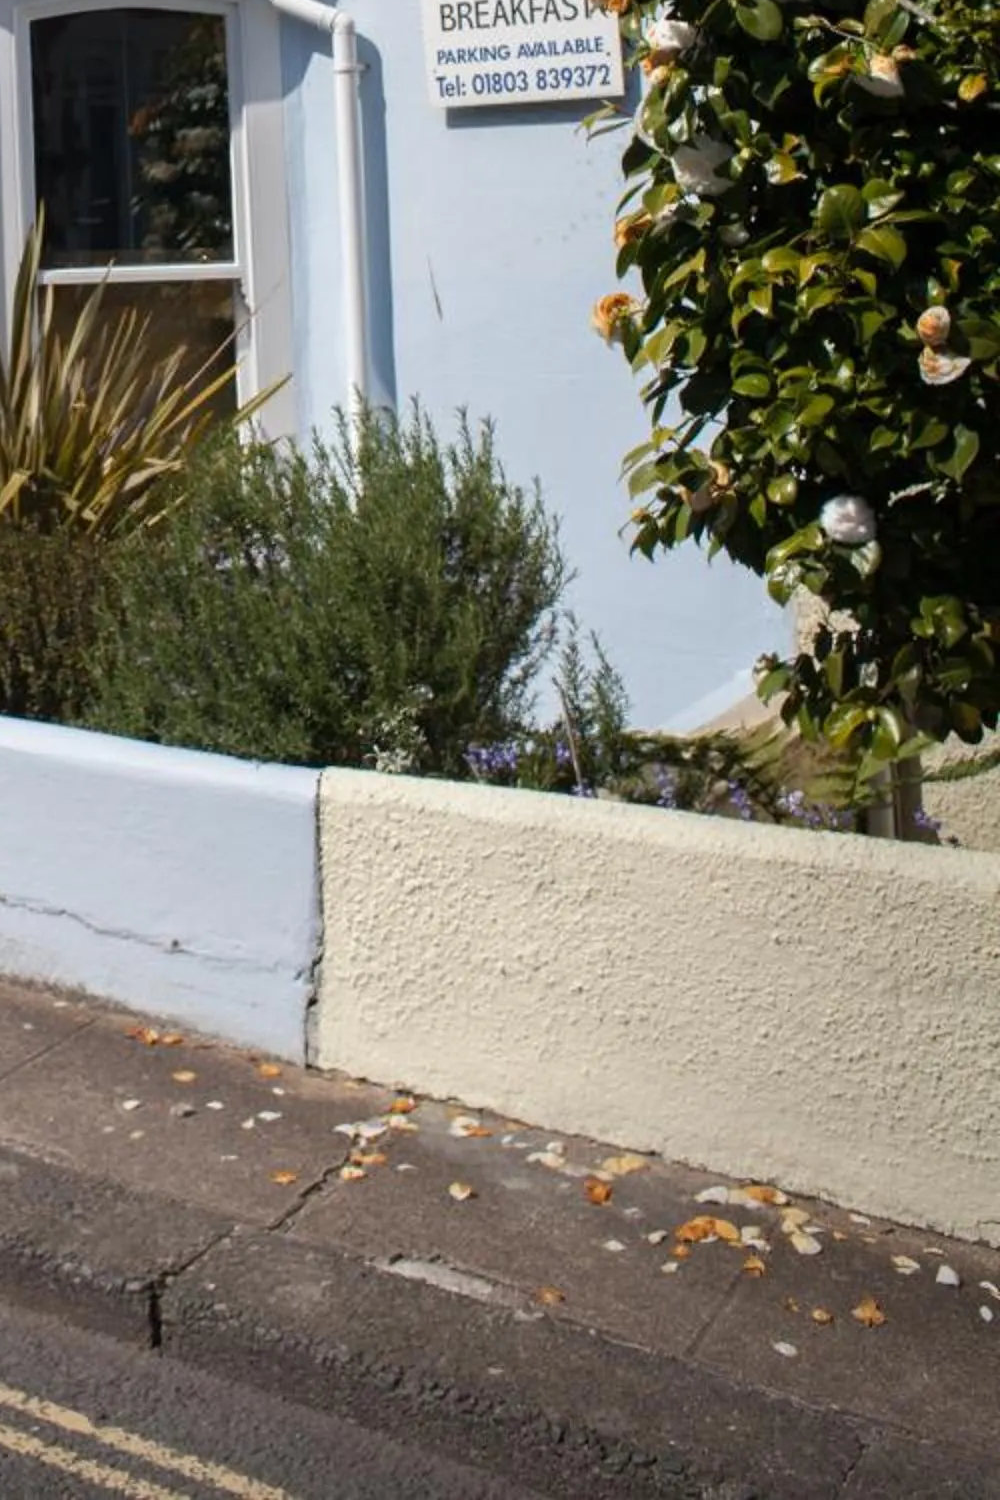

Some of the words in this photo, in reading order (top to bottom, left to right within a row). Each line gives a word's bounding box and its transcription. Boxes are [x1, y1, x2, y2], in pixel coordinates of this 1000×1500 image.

[437, 44, 511, 65] PARKING
[517, 36, 604, 59] AVAILABLE
[436, 74, 467, 98] Tel:
[472, 70, 529, 95] 01803
[536, 64, 611, 91] 839372
